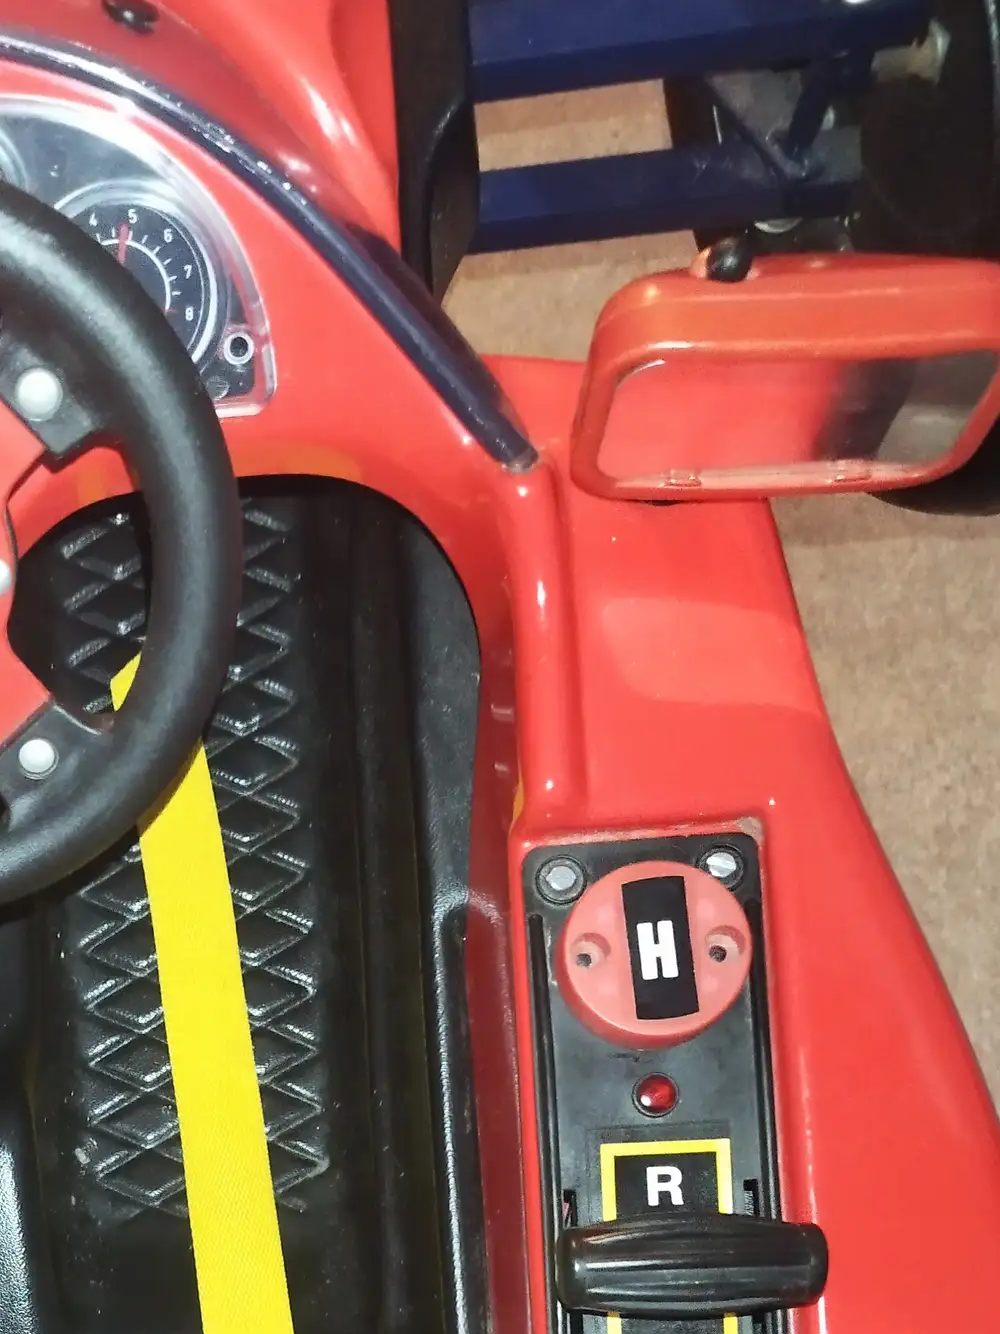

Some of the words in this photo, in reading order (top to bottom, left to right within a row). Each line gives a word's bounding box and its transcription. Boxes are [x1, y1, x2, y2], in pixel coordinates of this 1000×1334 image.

[88, 212, 98, 226] 4
[128, 208, 138, 224] 5
[163, 228, 173, 243] 6
[183, 264, 193, 279] 7
[185, 305, 194, 321] 8
[635, 921, 681, 982] H
[646, 1165, 684, 1206] R
